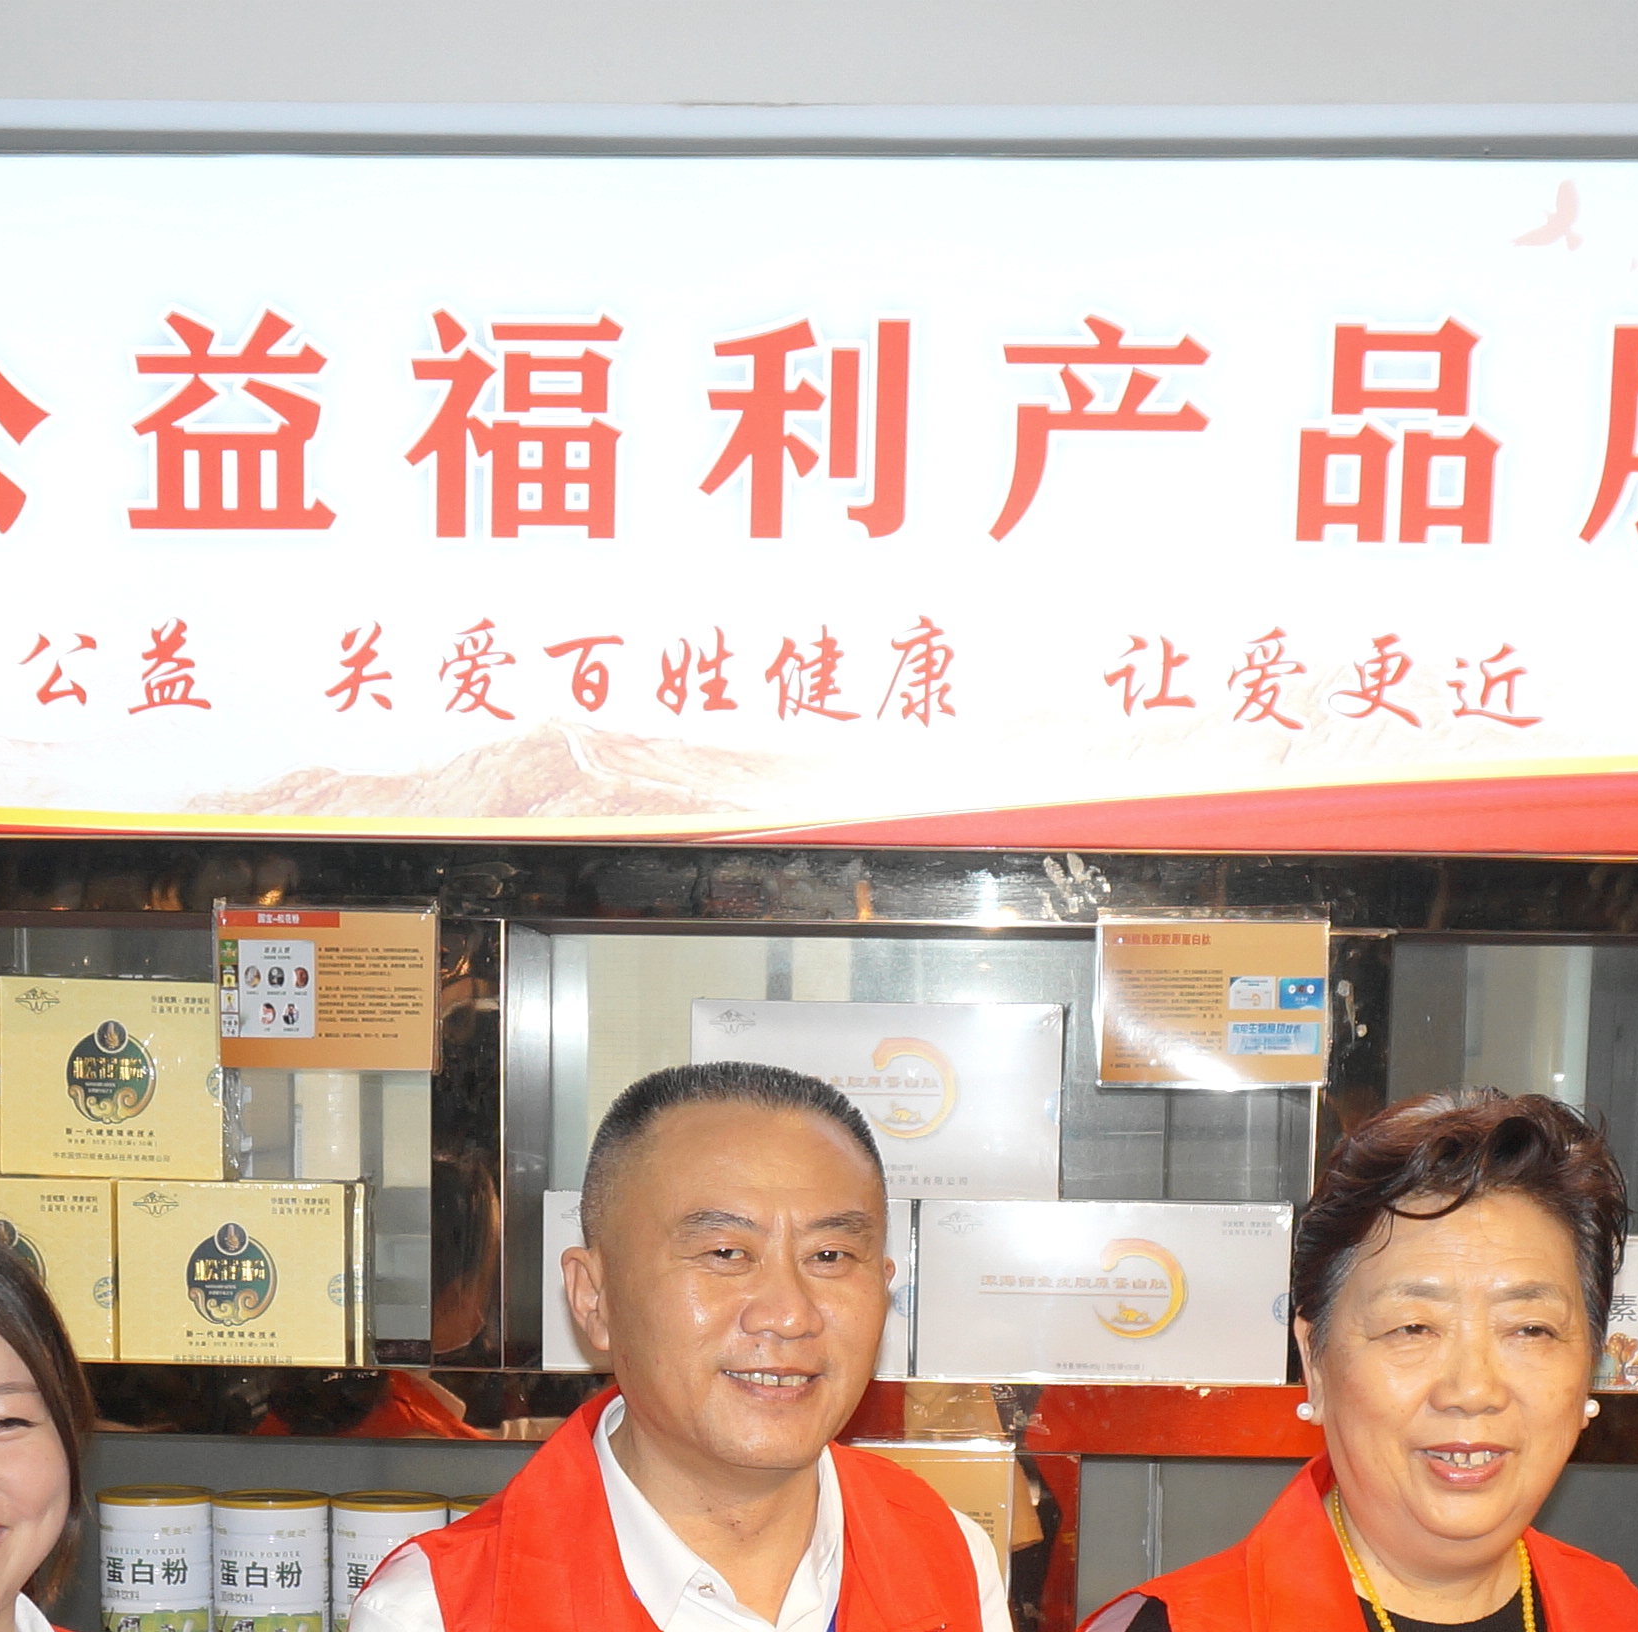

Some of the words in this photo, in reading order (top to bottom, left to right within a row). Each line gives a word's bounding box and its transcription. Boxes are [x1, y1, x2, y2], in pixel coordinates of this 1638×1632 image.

[325, 617, 958, 725] 关爱百姓健康
[1104, 630, 1543, 732] 让爱更近
[105, 1556, 189, 1586] 蛋白粉
[219, 1559, 303, 1589] 蛋白粉
